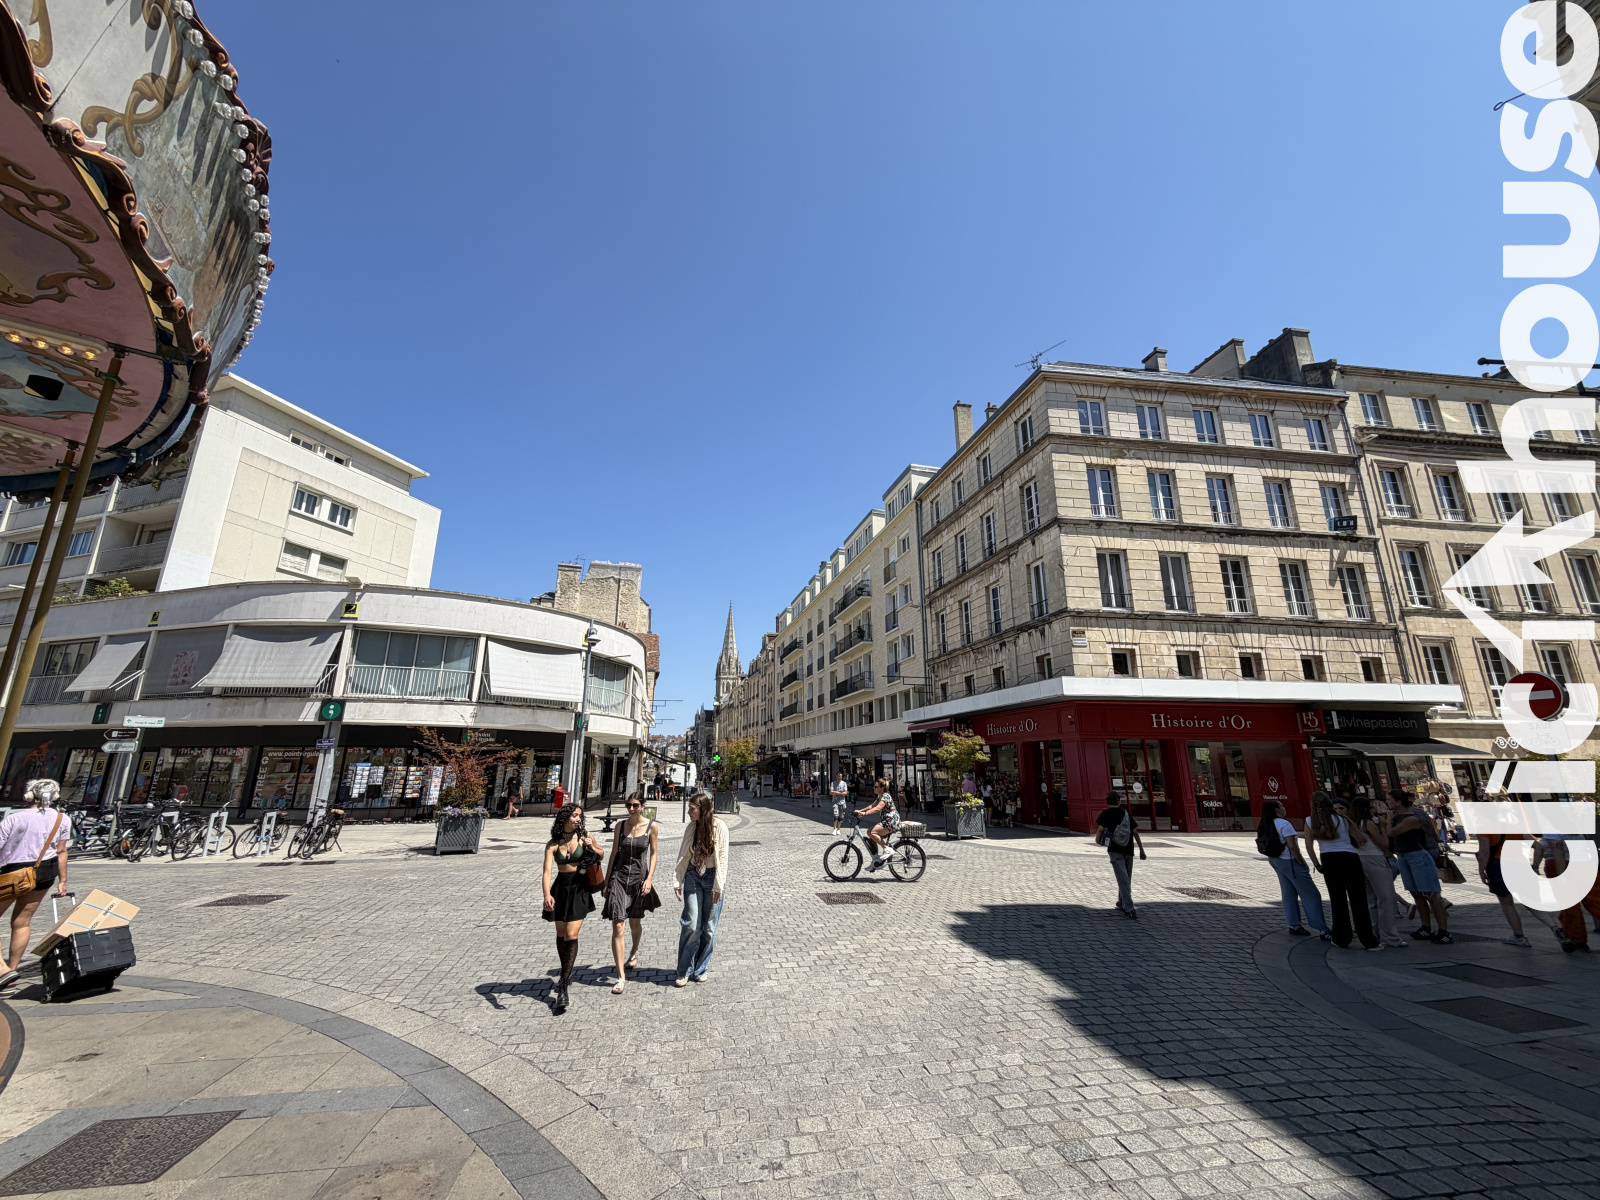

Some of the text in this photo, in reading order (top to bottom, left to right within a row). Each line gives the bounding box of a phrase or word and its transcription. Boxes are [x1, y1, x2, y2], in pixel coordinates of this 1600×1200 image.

[986, 718, 1039, 736] Histoire d'Or
[1151, 713, 1252, 730] Histoire d'Or
[1337, 716, 1418, 730] divinepassion
